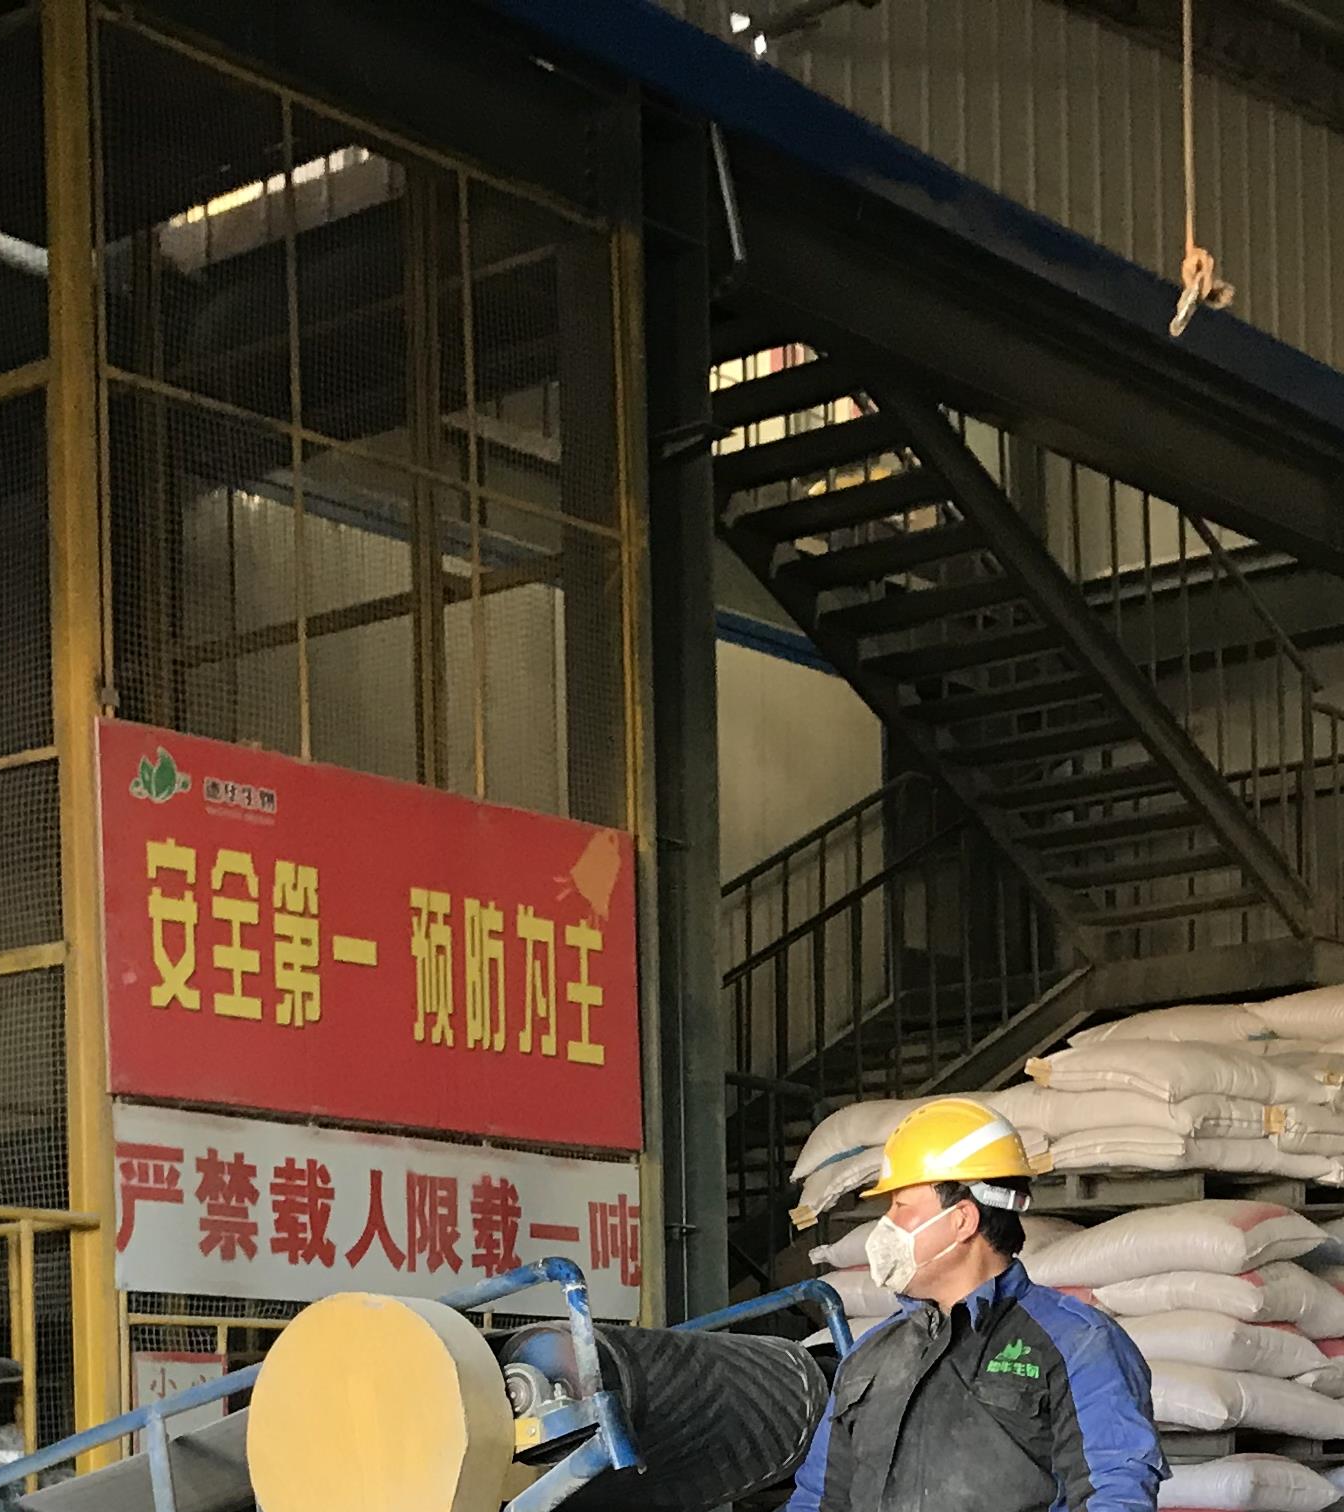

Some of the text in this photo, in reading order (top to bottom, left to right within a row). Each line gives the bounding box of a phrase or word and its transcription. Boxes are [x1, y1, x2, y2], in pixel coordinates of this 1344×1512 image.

[146, 837, 605, 1066] 安全第一 预防为主
[115, 1142, 640, 1288] 严禁载人限载一吨
